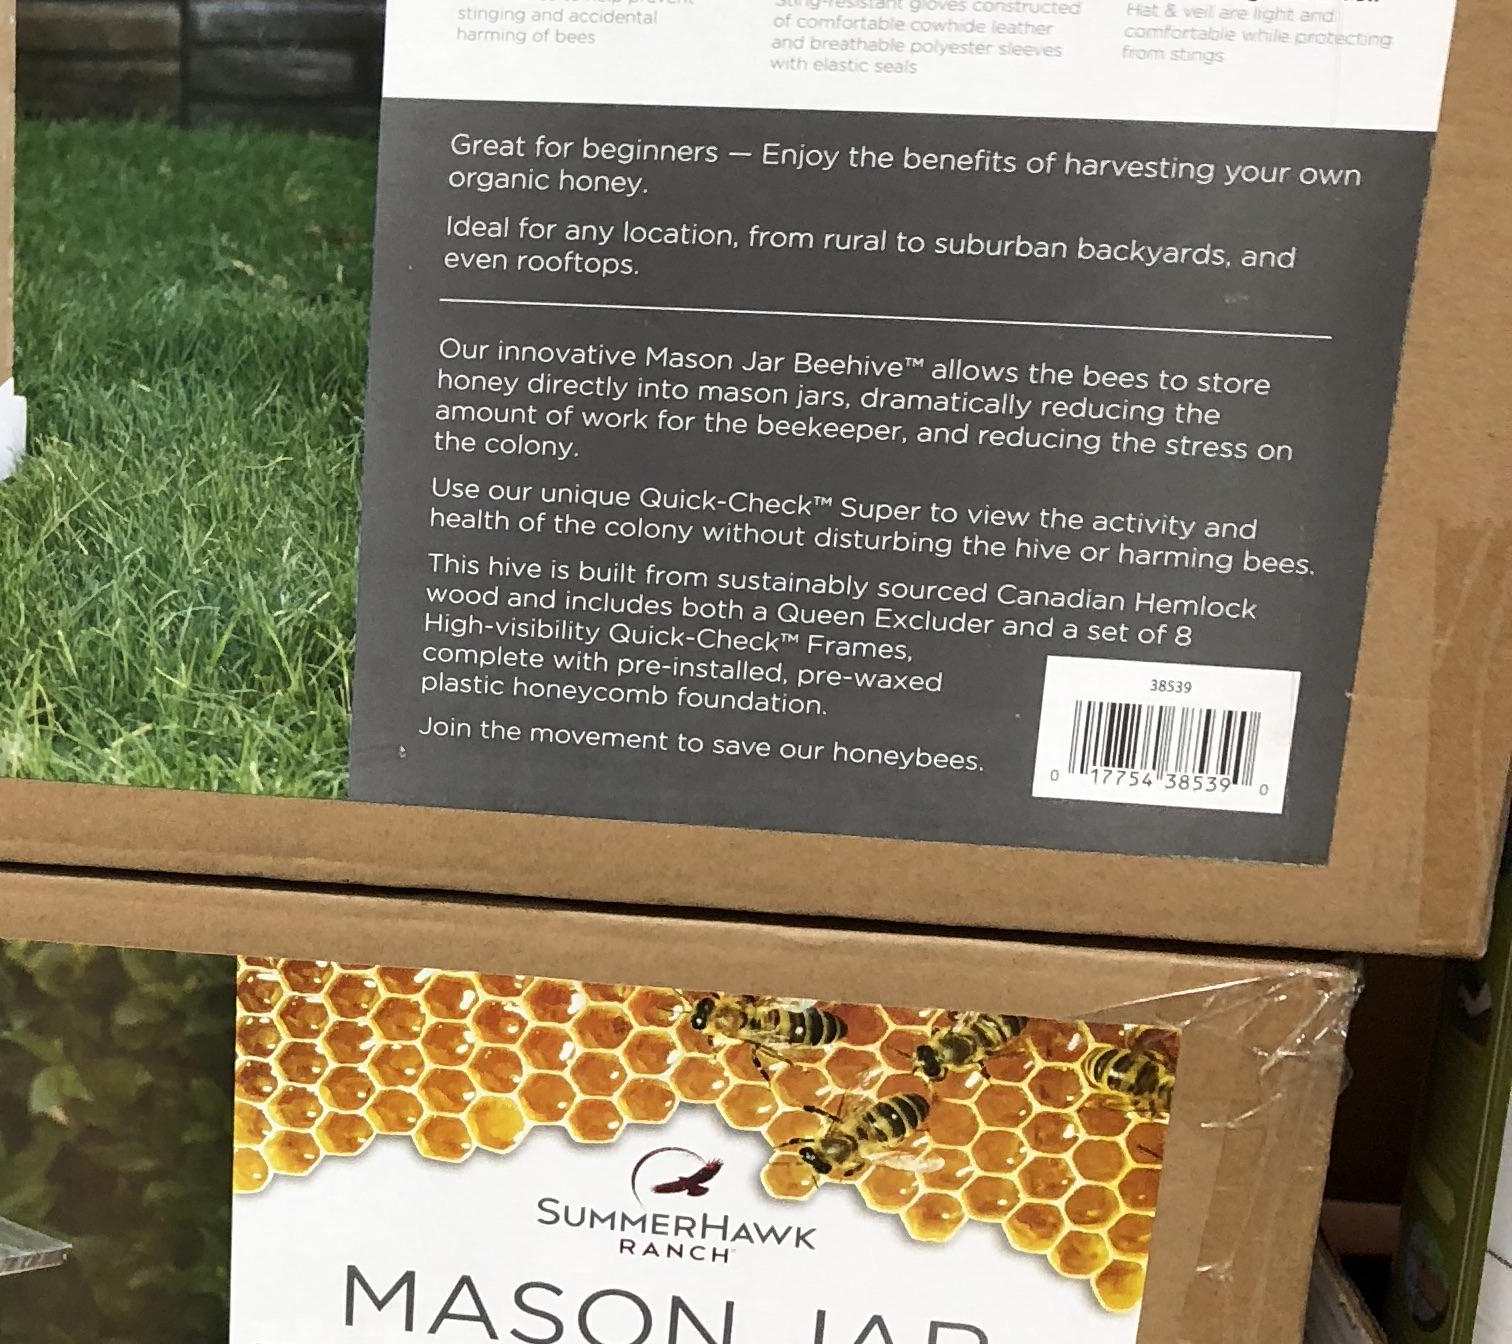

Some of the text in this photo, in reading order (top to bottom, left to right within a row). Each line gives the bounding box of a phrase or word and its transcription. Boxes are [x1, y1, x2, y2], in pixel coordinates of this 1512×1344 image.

[458, 8, 657, 24] stinging and accidental
[457, 27, 595, 45] harming of bees
[451, 133, 1361, 186] Great for beginners Enjoy the benefits of harvesting your own
[449, 168, 647, 197] organic honey.
[447, 216, 1296, 268] Ideal for any location, from rural to suburban backyards, and
[445, 250, 638, 277] even rooftops.
[440, 338, 489, 359] Our
[499, 340, 636, 366] innovative
[646, 347, 732, 370] Mason
[742, 351, 785, 372] Jar
[932, 359, 1018, 382] allows
[1029, 363, 1073, 385] the
[1083, 365, 1148, 389] bees
[1159, 370, 1188, 391] to
[1197, 373, 1270, 395] store
[425, 613, 600, 645] High-visibility
[808, 635, 912, 662] Frames,
[423, 646, 942, 692] complete with pre-installed, pre-waxed
[1150, 679, 1192, 693] 38539
[422, 672, 826, 715] plastic honeycomb foundation.
[419, 717, 983, 771] Join the movement to save our honeybees.
[1050, 769, 1269, 796] 0 17754 38539 0
[620, 1239, 728, 1263] RANCH
